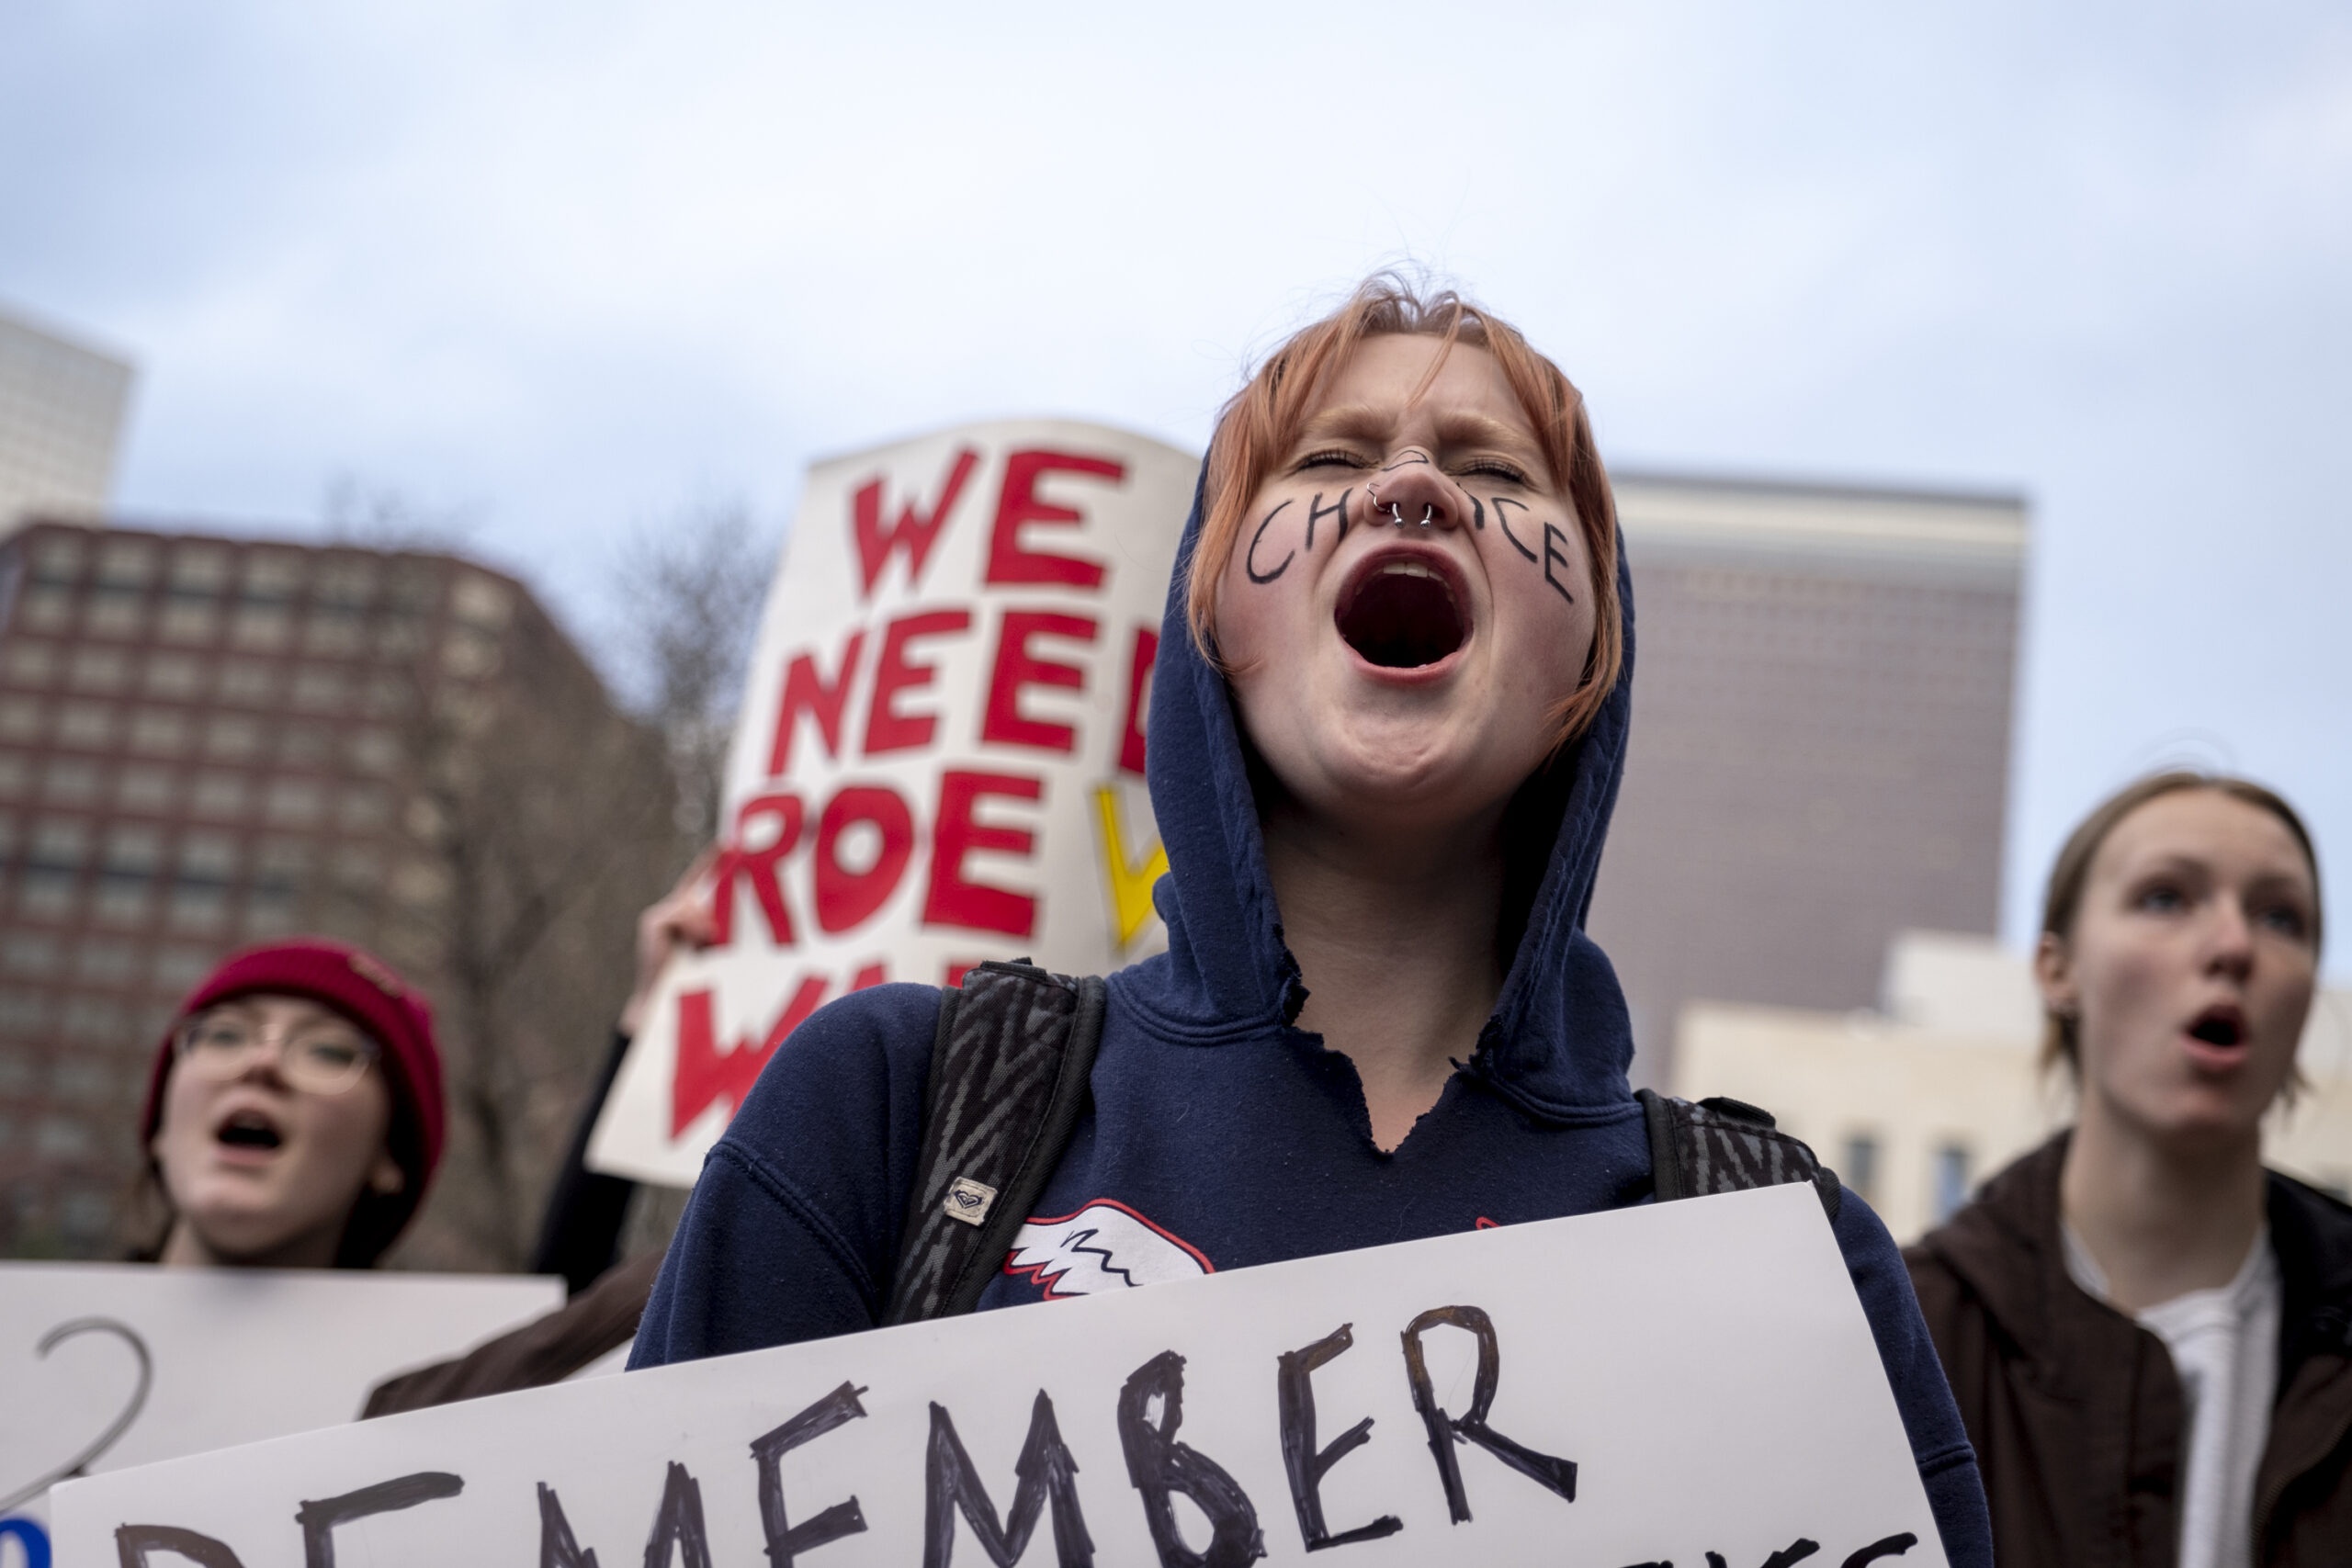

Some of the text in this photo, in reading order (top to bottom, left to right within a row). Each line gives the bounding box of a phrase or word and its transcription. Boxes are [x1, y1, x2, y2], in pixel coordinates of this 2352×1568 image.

[851, 447, 1128, 600] WE
[1245, 449, 1575, 604] CHOICE
[711, 768, 1046, 948] ROE
[114, 1304, 1577, 1568] MEMBER
